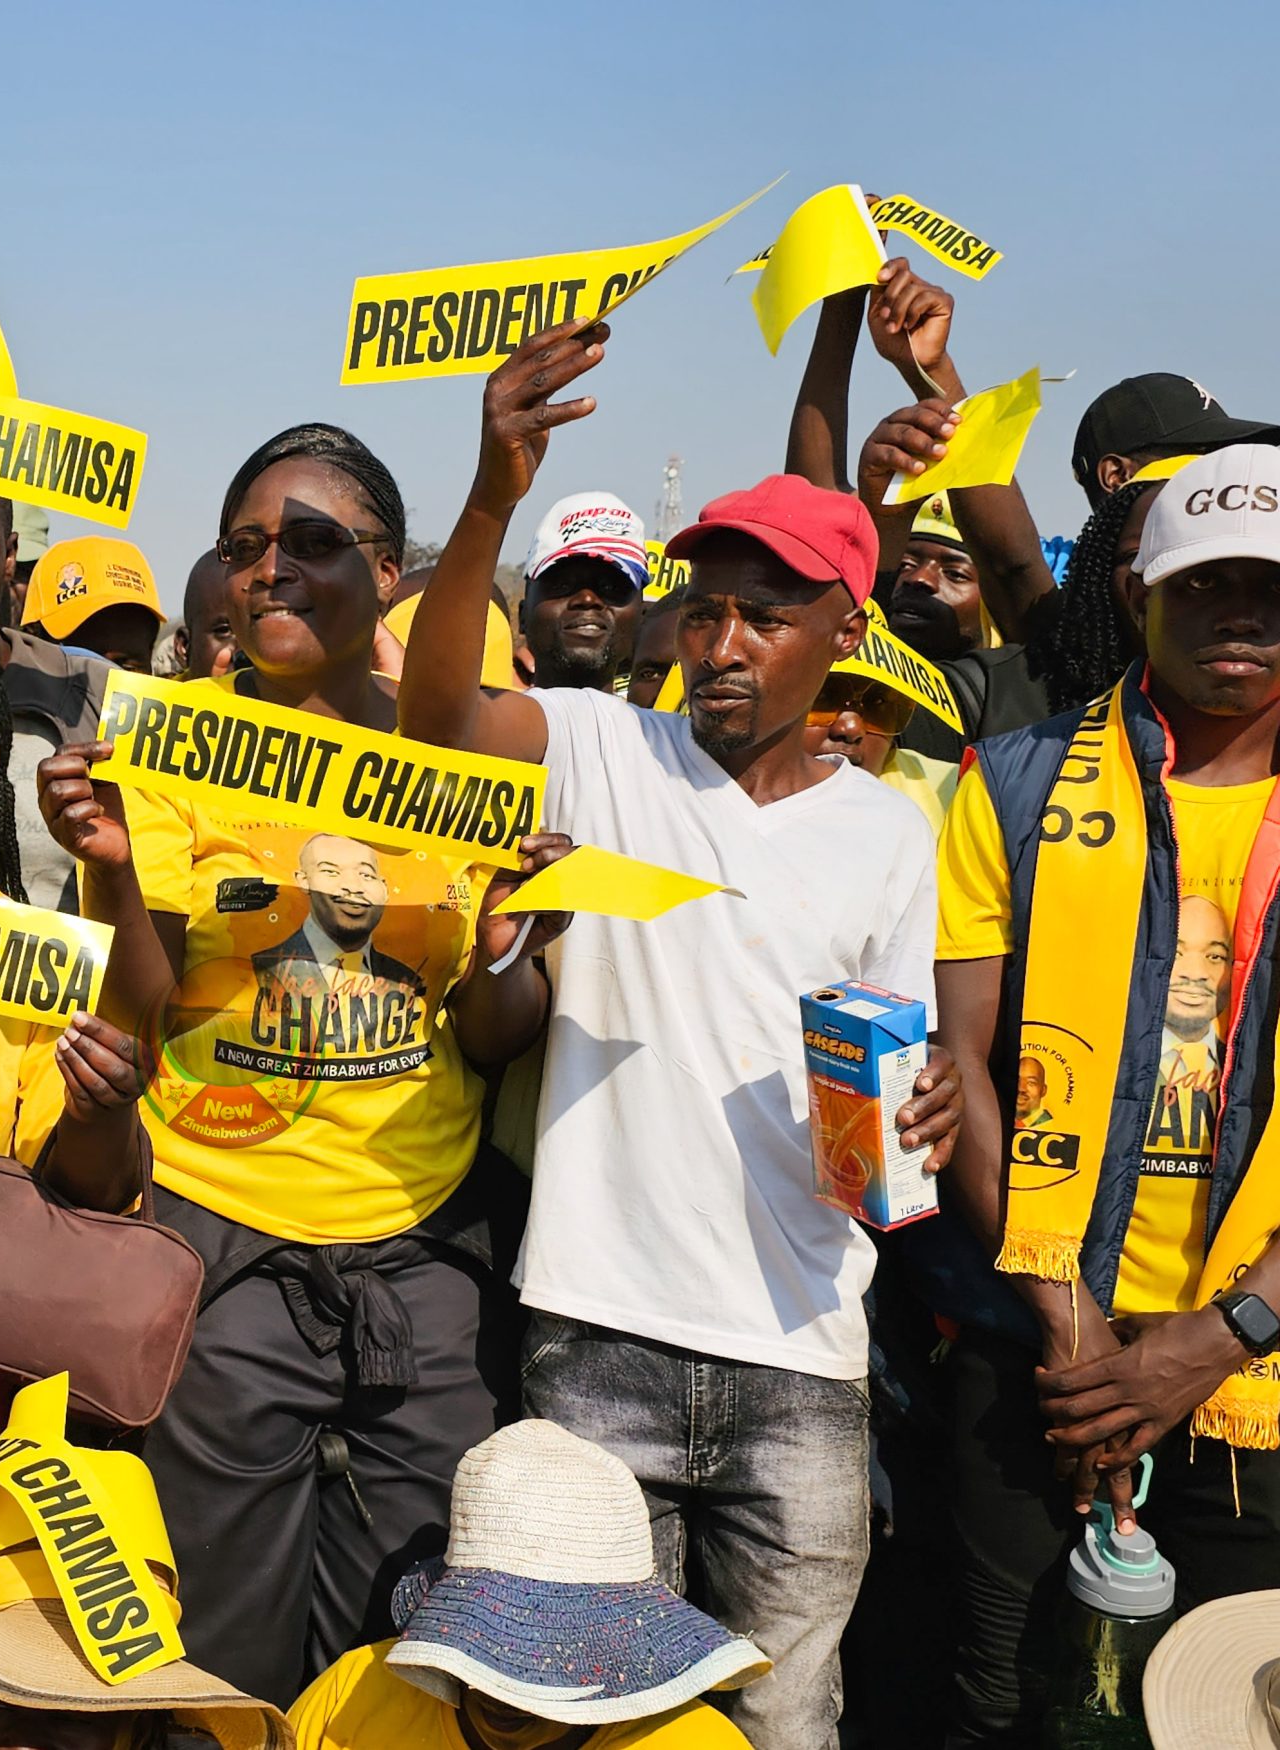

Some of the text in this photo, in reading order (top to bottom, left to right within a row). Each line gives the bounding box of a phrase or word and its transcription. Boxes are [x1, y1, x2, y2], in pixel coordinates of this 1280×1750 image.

[871, 201, 996, 270] CHAMISA
[348, 279, 587, 370] PRESIDENT
[1185, 484, 1279, 516] GCS
[58, 585, 86, 603] CCC
[104, 691, 535, 851] PRESIDENT CHAMISA
[251, 987, 423, 1054] CHANGE
[227, 1049, 254, 1066] NEW
[256, 1056, 301, 1075] GREAT
[303, 1062, 376, 1077] ZIMBABWE
[378, 1057, 399, 1074] FOR
[804, 1030, 866, 1063] CASCADE
[1050, 1049, 1068, 1066] FOR
[906, 1202, 925, 1215] Litre
[10, 1457, 164, 1677] CHAMISA
